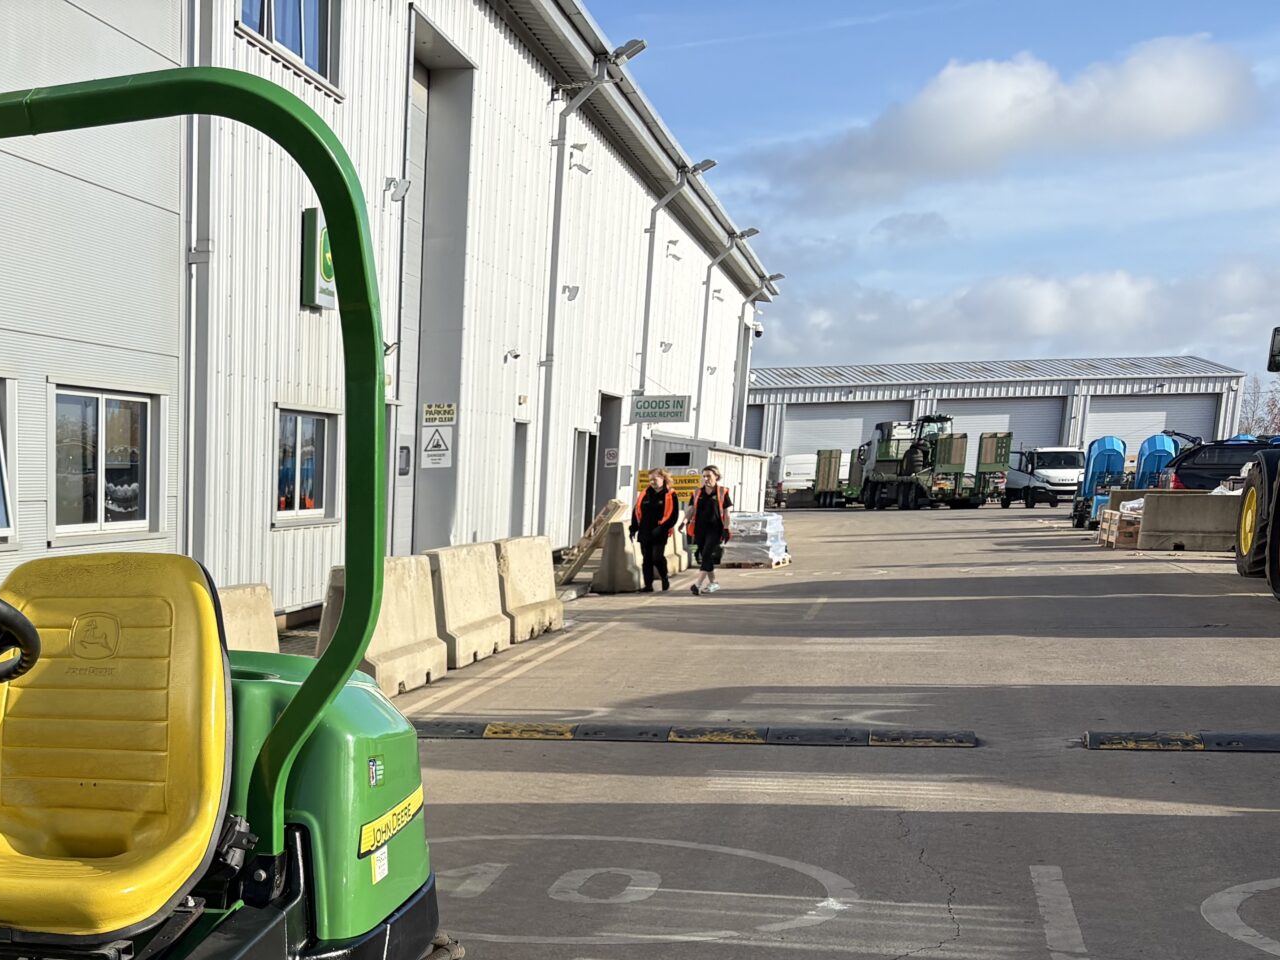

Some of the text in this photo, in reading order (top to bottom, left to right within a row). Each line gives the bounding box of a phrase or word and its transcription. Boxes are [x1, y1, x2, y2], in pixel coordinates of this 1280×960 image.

[635, 400, 684, 410] GOODS IN
[425, 408, 455, 416] PARKING
[370, 803, 412, 848] JOHN DEERE
